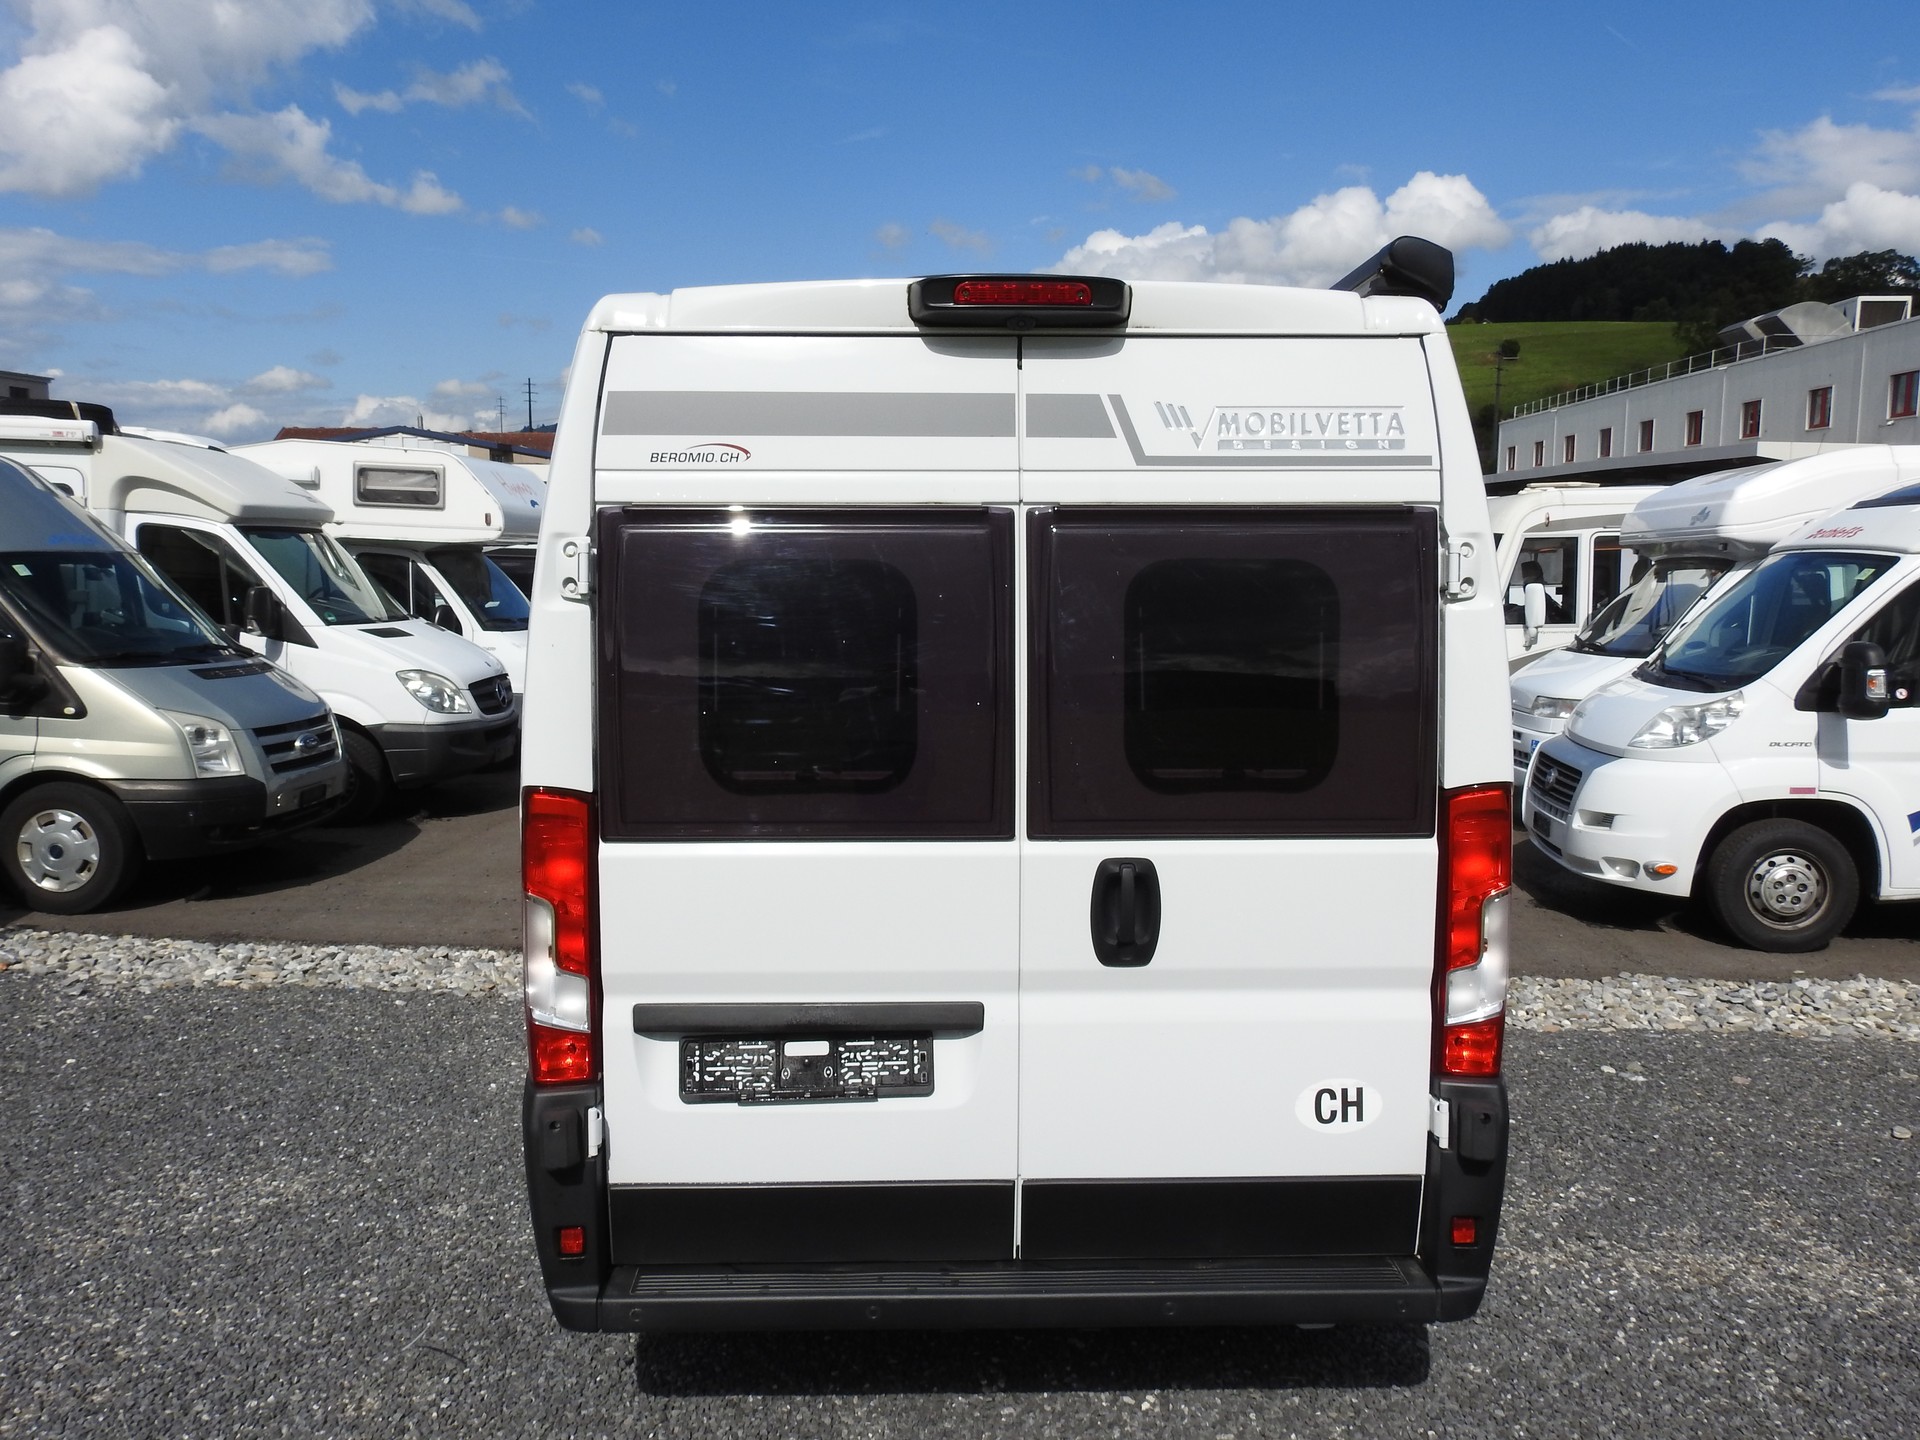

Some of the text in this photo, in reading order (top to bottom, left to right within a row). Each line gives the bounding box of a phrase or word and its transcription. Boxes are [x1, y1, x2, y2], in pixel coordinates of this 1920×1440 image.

[1217, 412, 1405, 437] MOBILVETTA
[1232, 439, 1391, 450] DESIGN
[650, 452, 740, 463] BEROMIO.CH
[1314, 1086, 1364, 1125] CH
